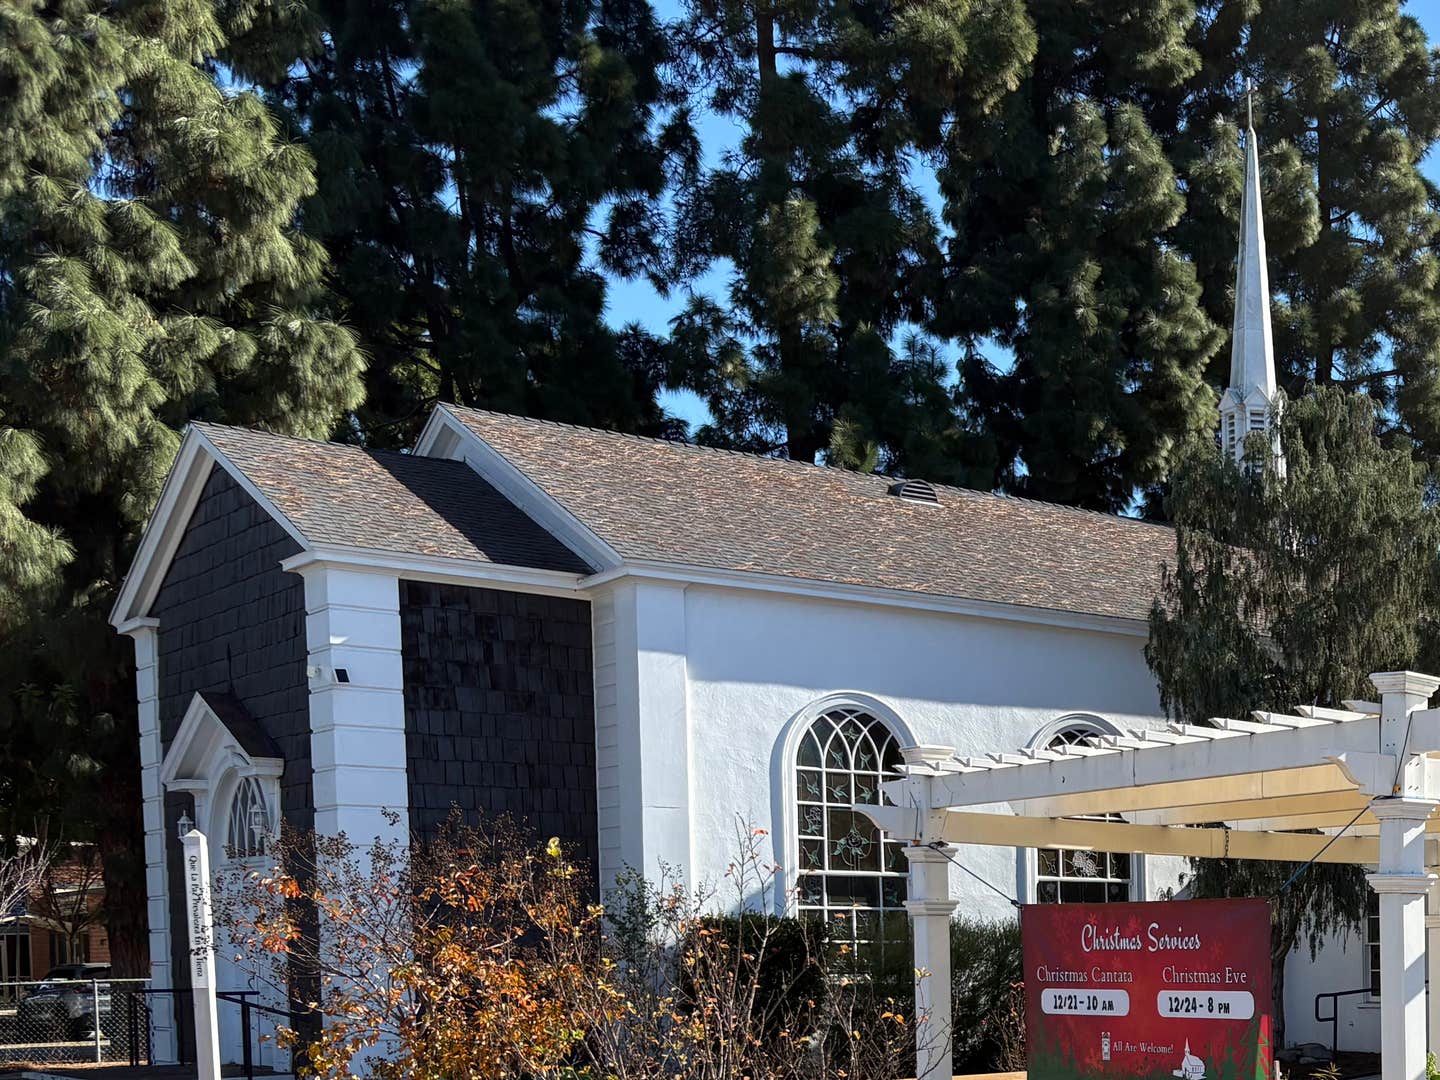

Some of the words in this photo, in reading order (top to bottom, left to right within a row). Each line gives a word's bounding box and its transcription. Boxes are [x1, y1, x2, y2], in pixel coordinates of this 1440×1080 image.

[189, 855, 198, 871] Que
[191, 873, 199, 881] La
[1081, 923, 1142, 953] Christmas
[1147, 922, 1202, 953] Services
[196, 958, 204, 977] Tierra
[1036, 965, 1088, 983] Christmas
[1091, 966, 1134, 983] Cantata
[1162, 966, 1221, 984] Christmas
[1224, 966, 1248, 984] Eve
[1101, 1000, 1115, 1011] AM
[1207, 996, 1214, 1014] 8
[1218, 1002, 1230, 1014] PM
[1112, 1040, 1123, 1052] All
[1125, 1041, 1137, 1052] Are
[1139, 1041, 1174, 1054] Welcome!
